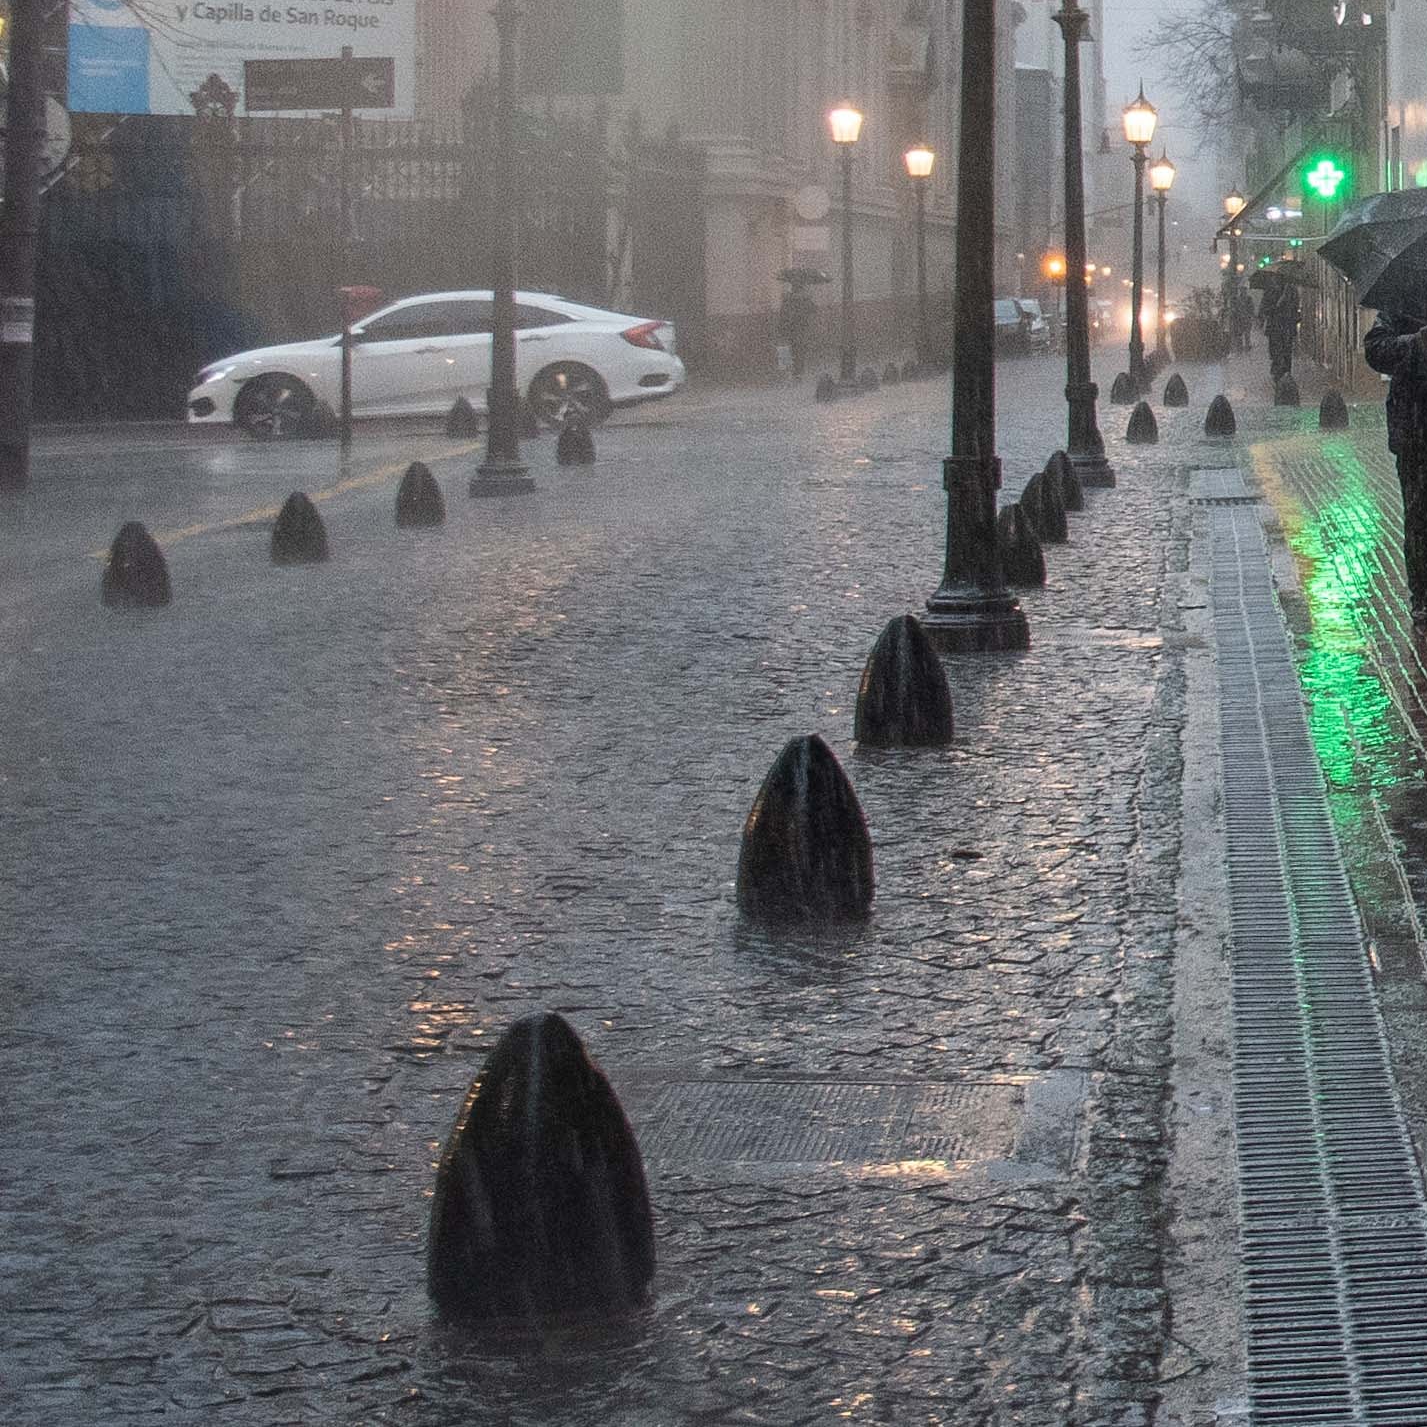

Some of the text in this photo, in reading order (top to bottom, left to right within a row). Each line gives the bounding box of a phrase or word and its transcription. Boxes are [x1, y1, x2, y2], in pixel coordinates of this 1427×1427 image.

[176, 2, 381, 32] y Capilla de San Roque
